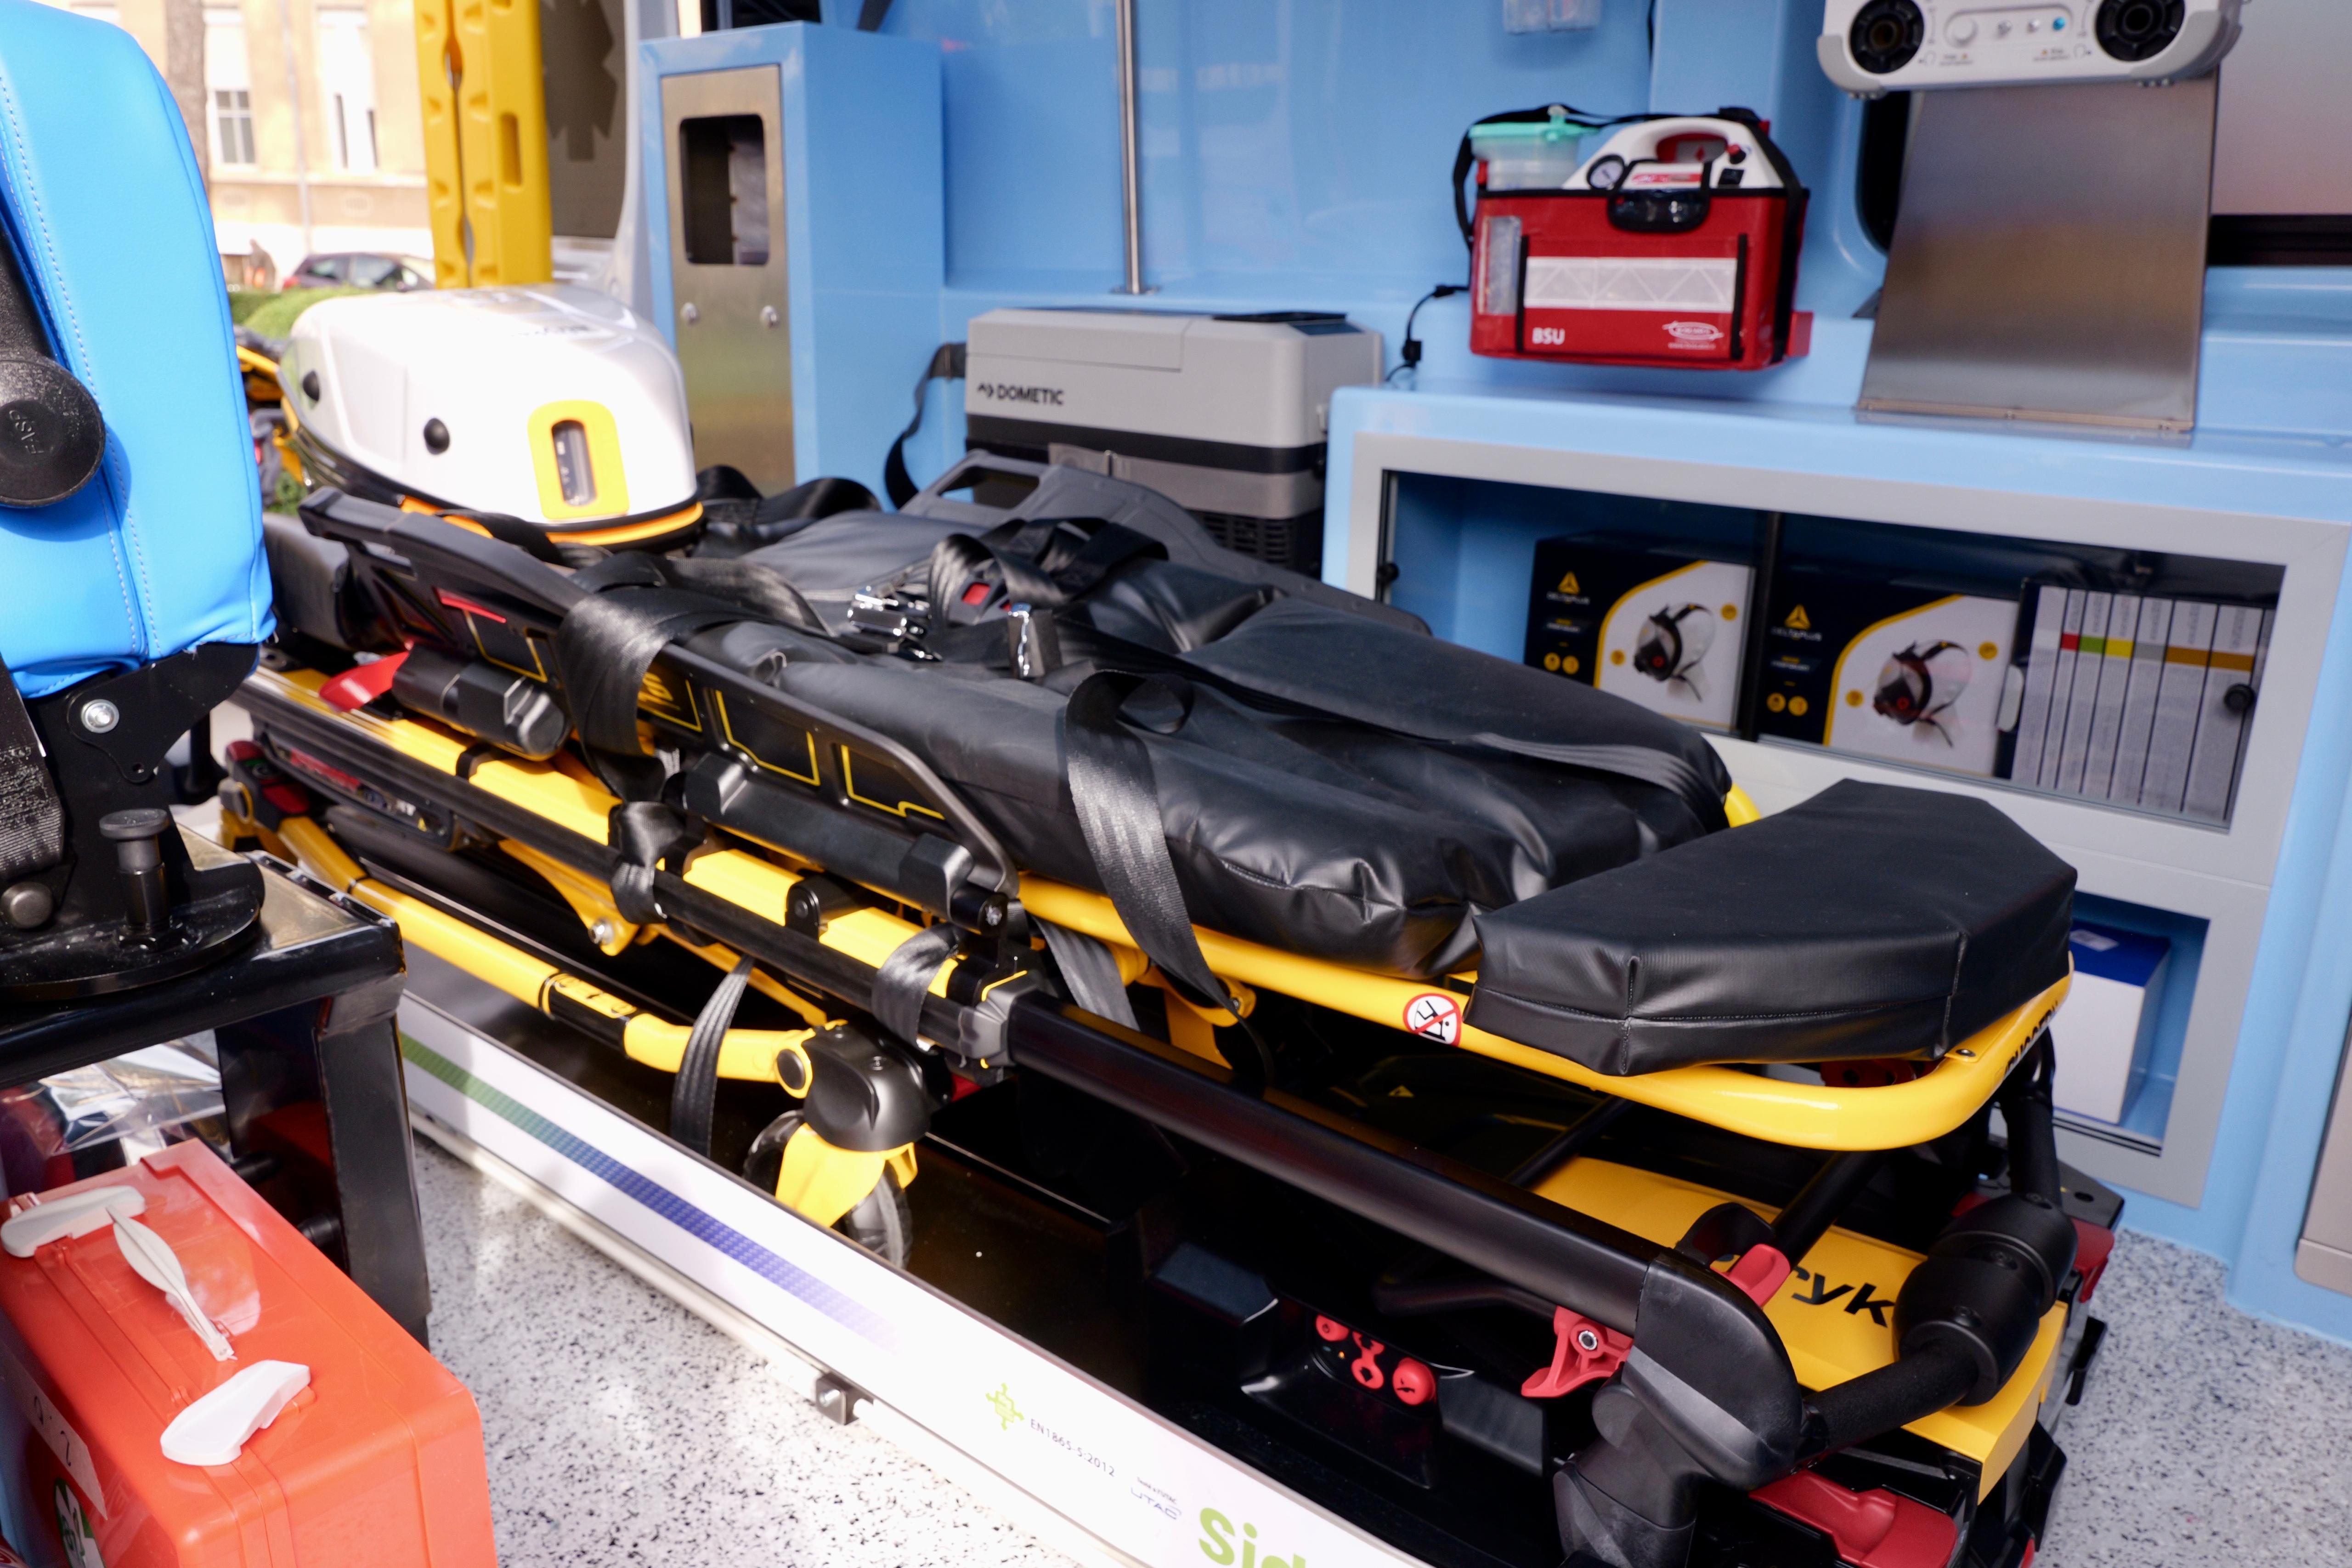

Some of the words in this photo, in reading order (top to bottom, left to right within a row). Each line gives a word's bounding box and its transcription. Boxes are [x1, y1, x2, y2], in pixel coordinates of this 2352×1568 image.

[1532, 327, 1566, 345] BSU
[997, 384, 1064, 405] DOMETIC
[1131, 1487, 1182, 1520] UTAC
[1199, 1507, 1306, 1568] Si
